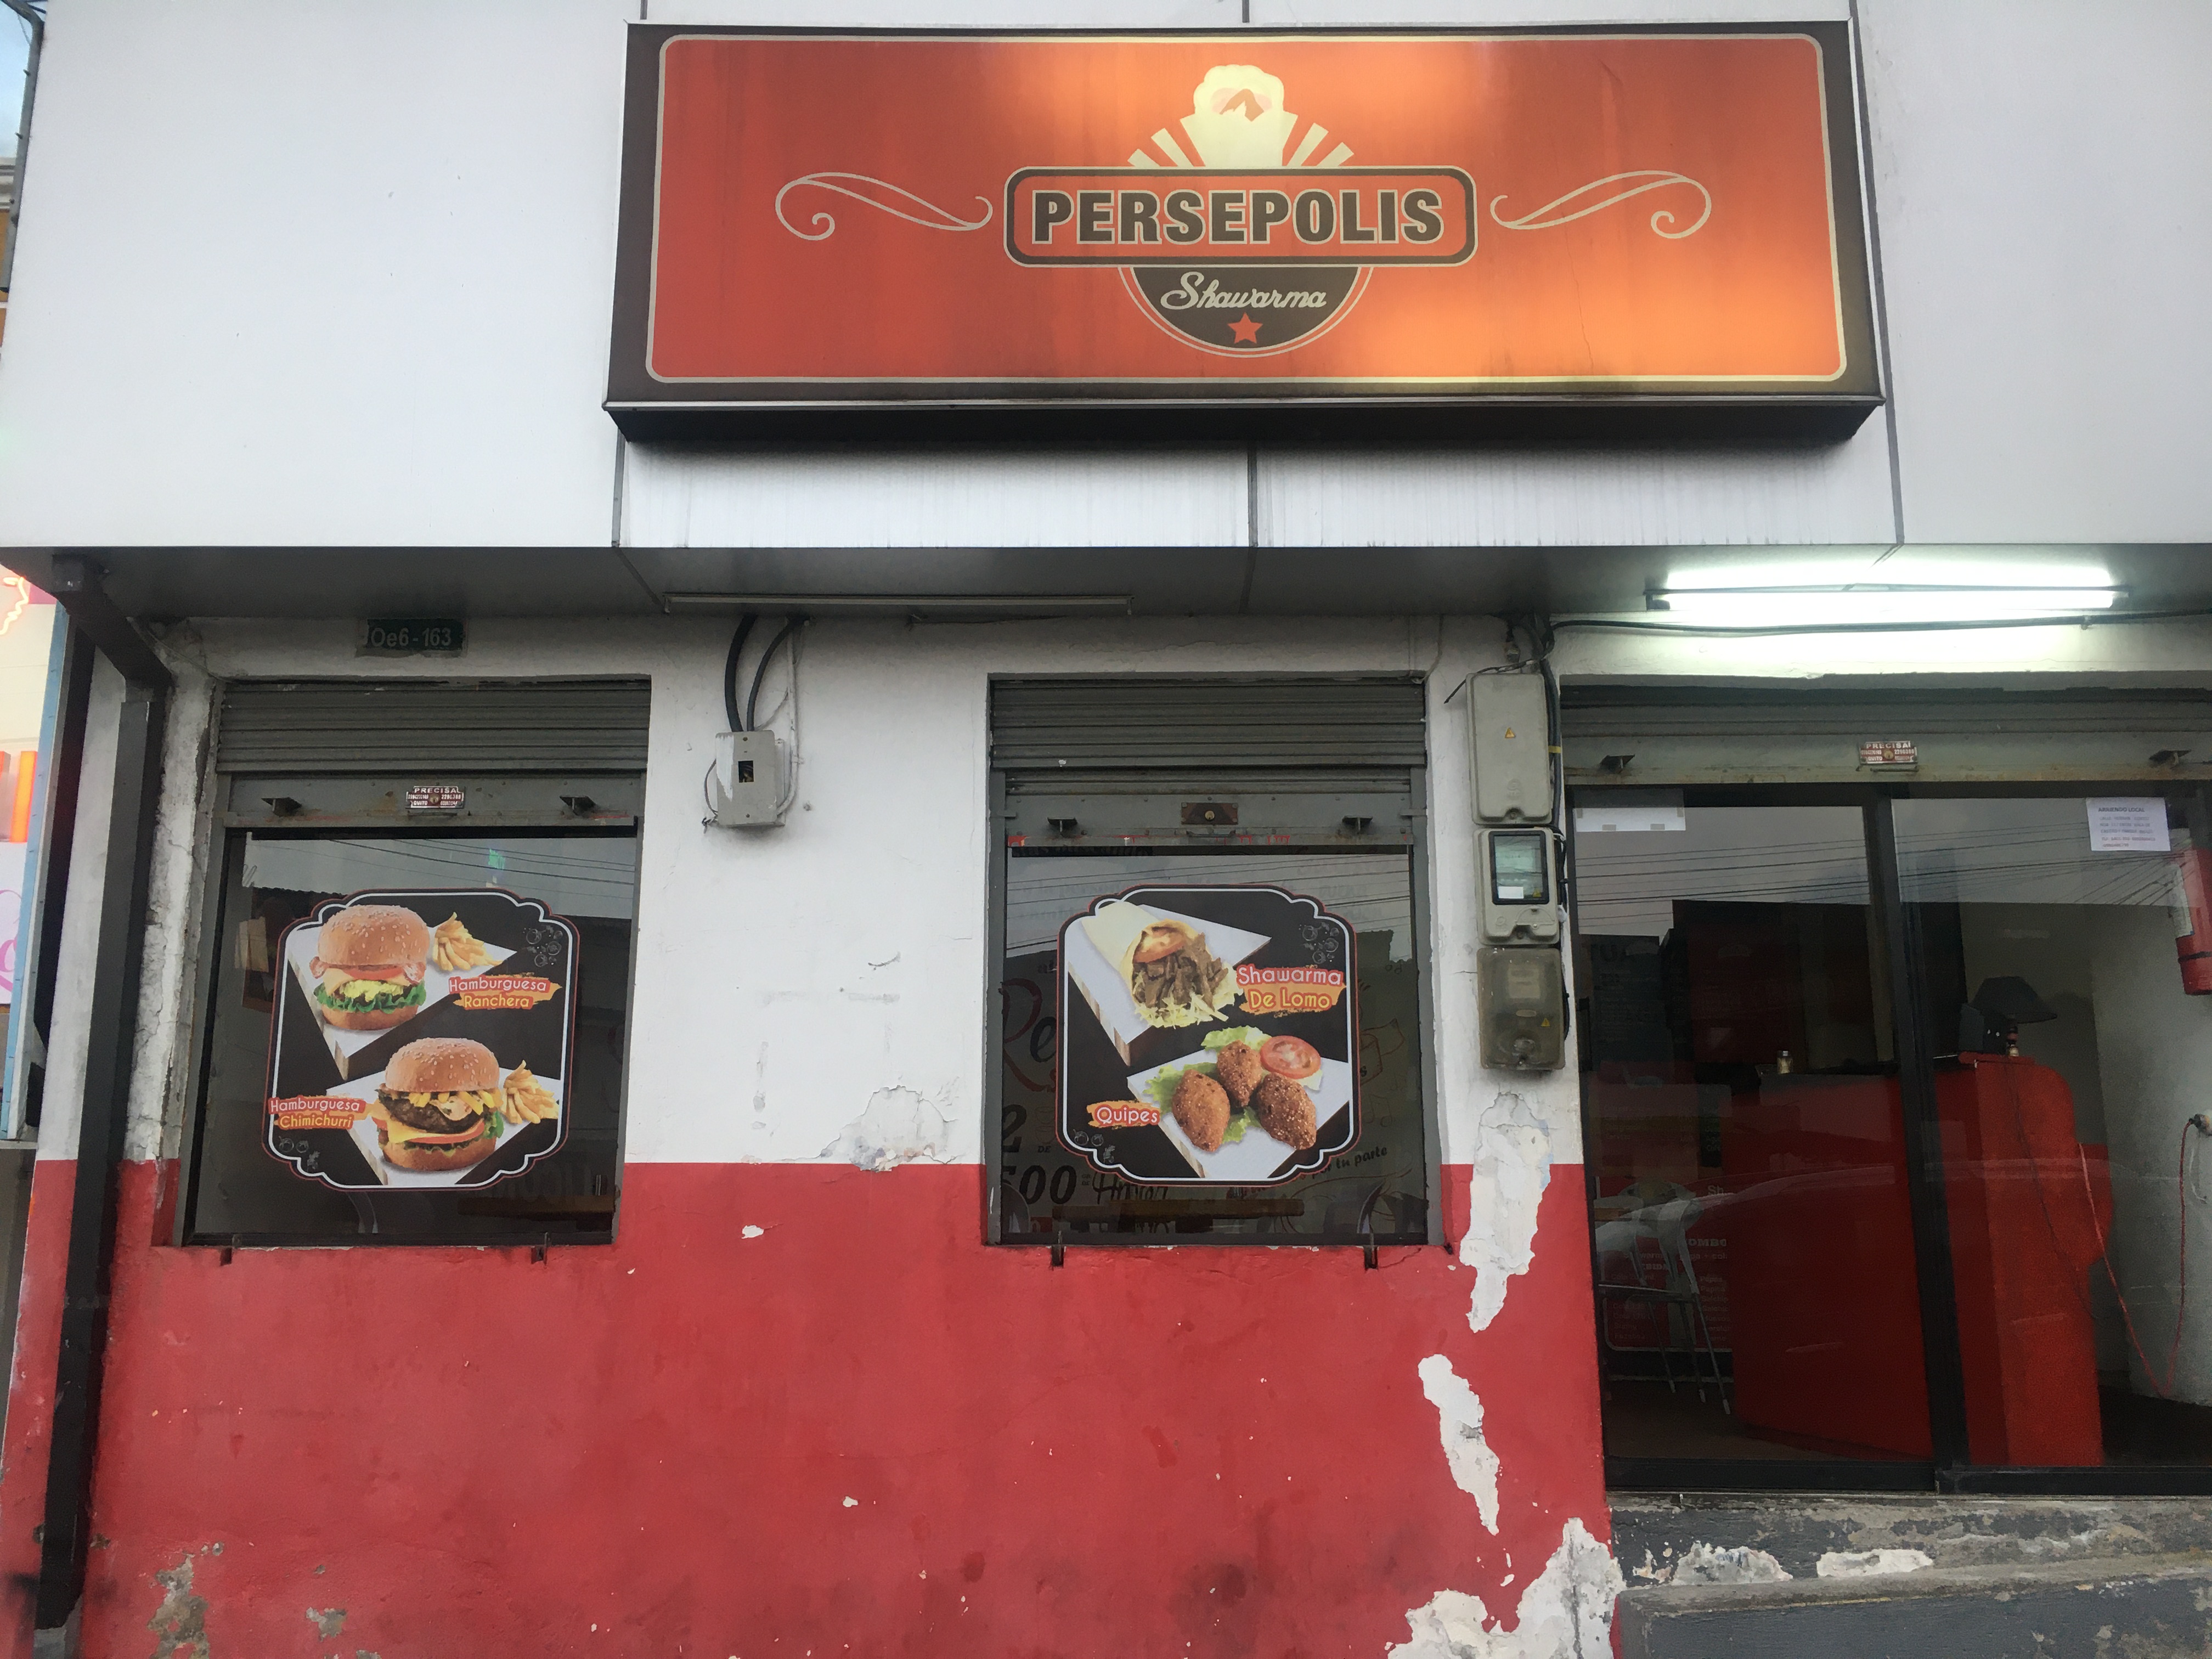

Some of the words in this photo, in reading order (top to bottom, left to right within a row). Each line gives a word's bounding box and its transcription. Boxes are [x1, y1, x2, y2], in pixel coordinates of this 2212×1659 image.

[1032, 189, 1444, 245] PERSEPOLIS
[1160, 271, 1327, 311] Shawarma
[449, 978, 547, 992] Hamburguesa
[1238, 966, 1343, 986] Shawarma
[464, 995, 529, 1008] Ranchera
[1250, 990, 1274, 1009] De
[1283, 990, 1330, 1009] Lomo
[270, 1098, 360, 1113] Hamburguesa
[280, 1114, 353, 1128] Chimichurri
[1096, 1107, 1158, 1125] Quipes
[1336, 1158, 1350, 1169] tu
[1354, 1146, 1388, 1167] parte
